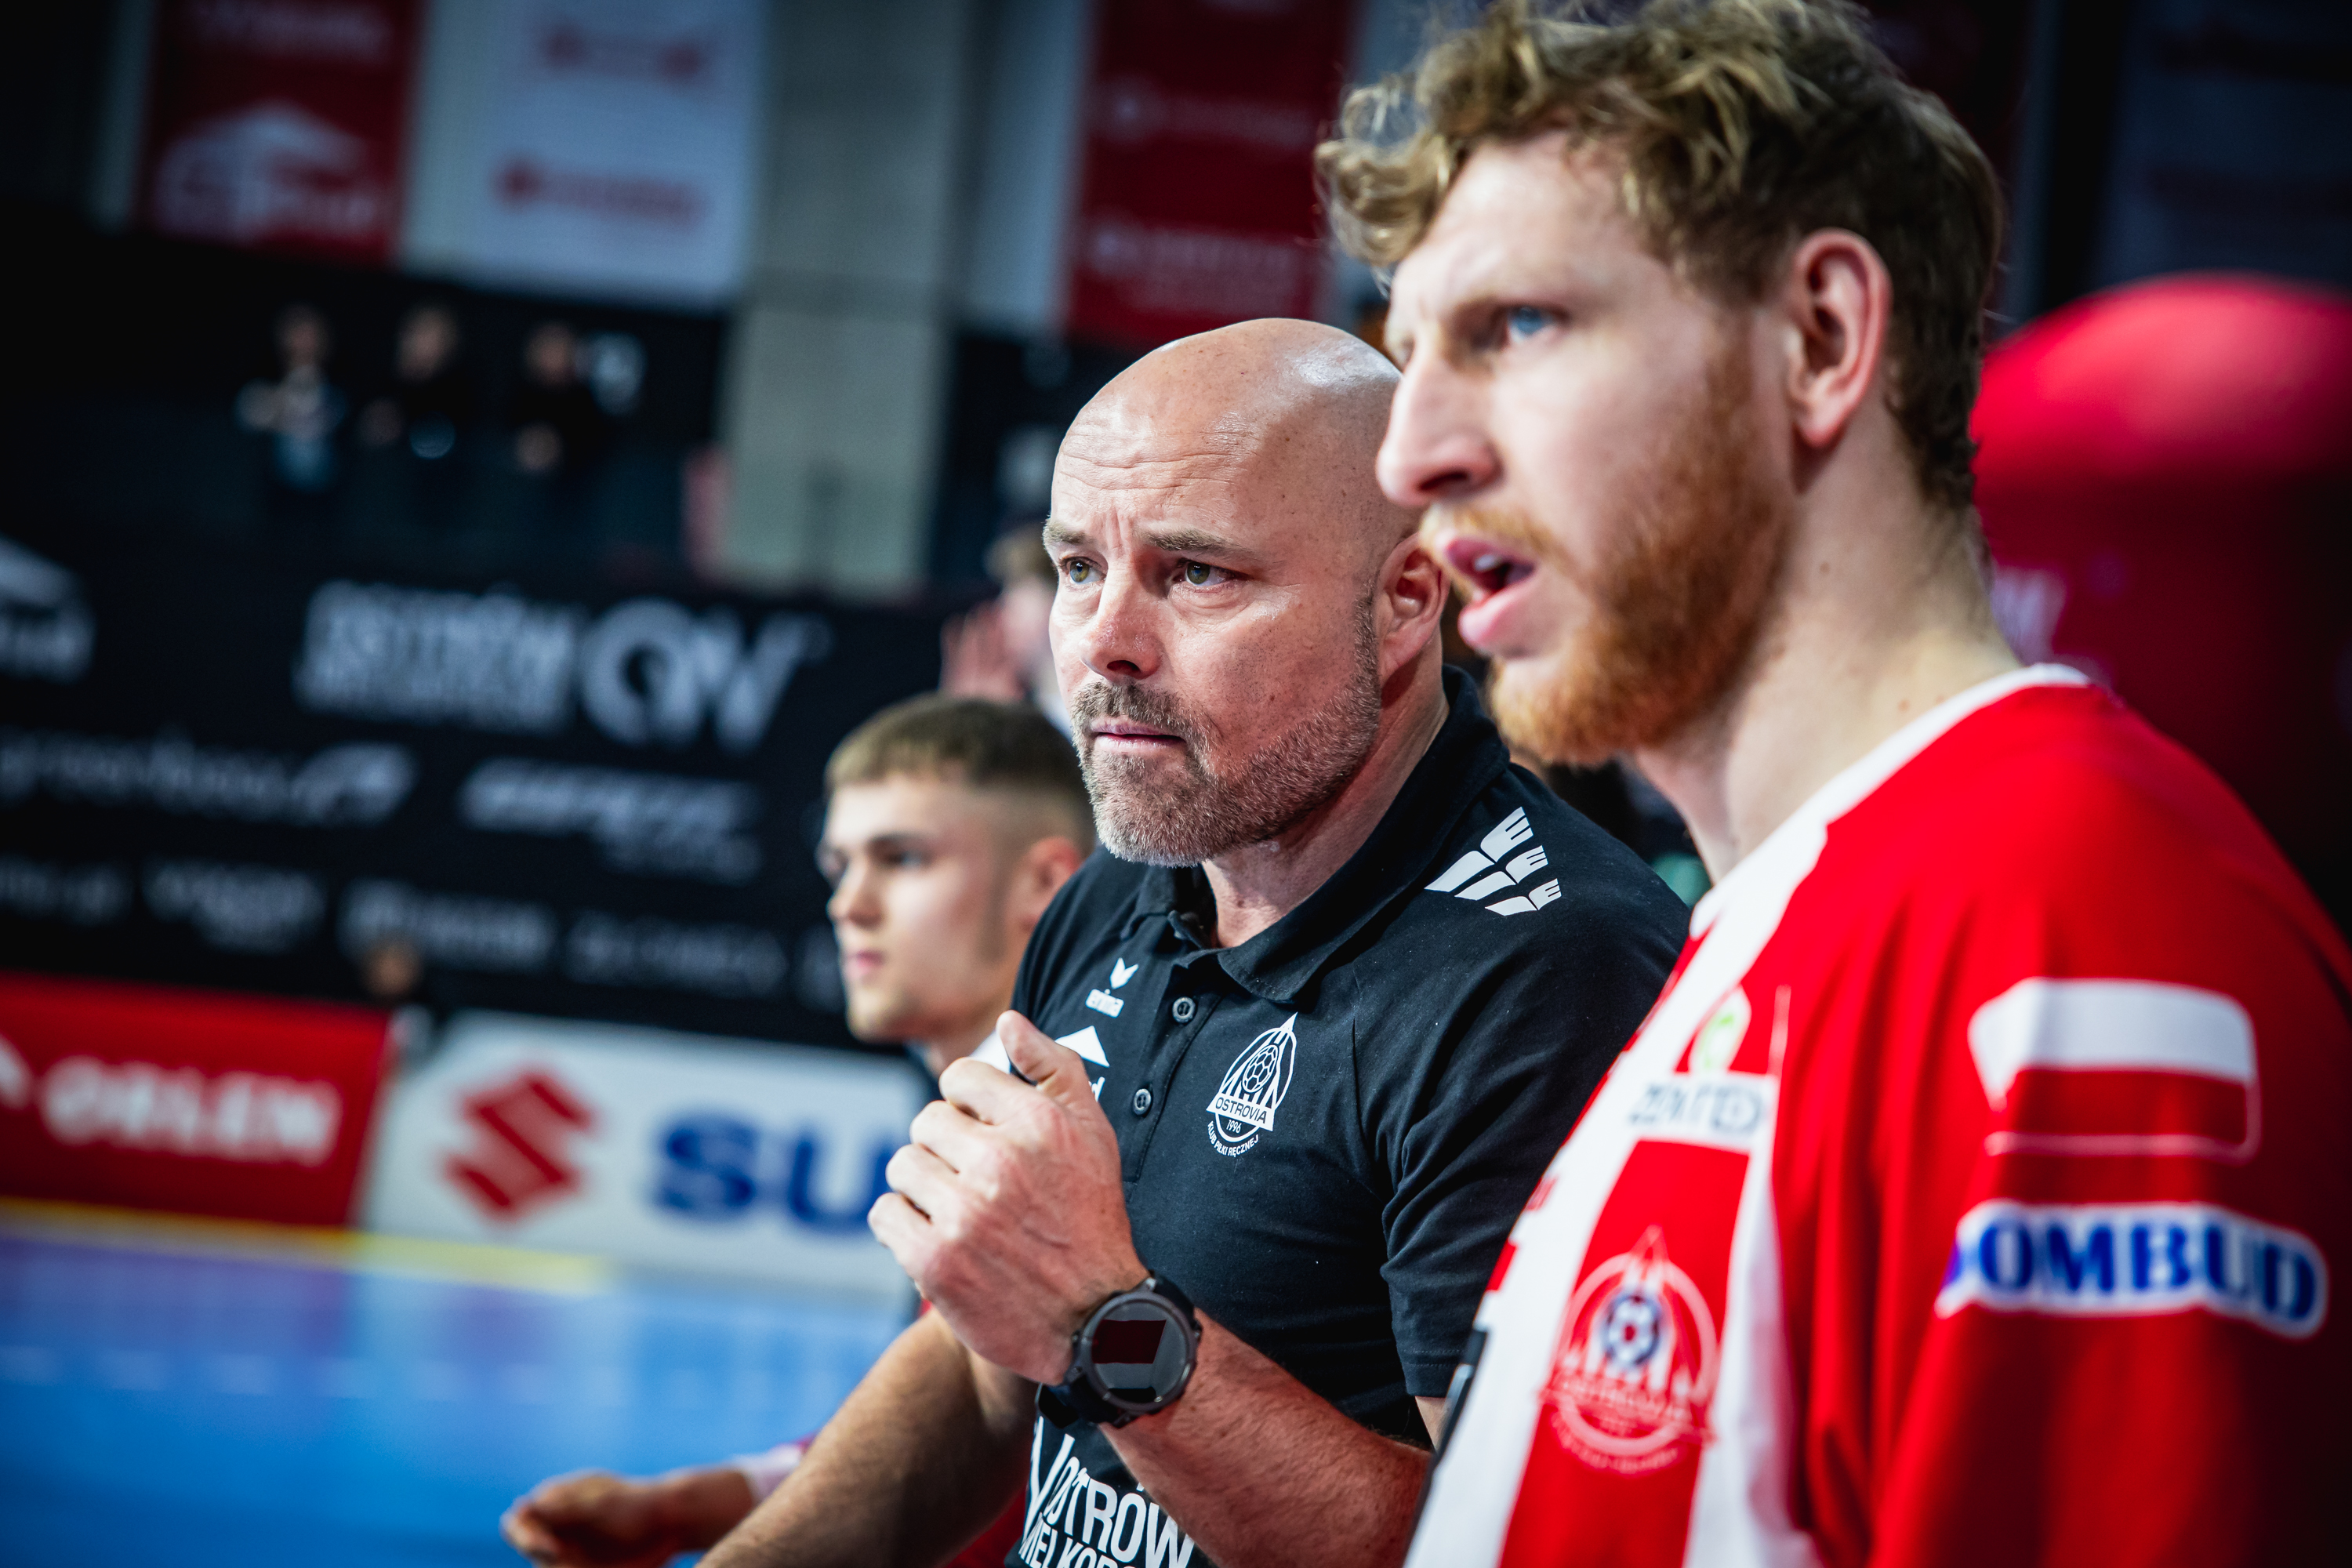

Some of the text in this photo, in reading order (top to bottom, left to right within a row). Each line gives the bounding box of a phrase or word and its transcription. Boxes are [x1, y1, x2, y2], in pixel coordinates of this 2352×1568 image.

[1215, 1097, 1268, 1124] OSTROVIA
[1207, 1120, 1218, 1145] KLUB
[1228, 1134, 1259, 1158] RĘCZNEJ
[1225, 1119, 1243, 1134] 1996
